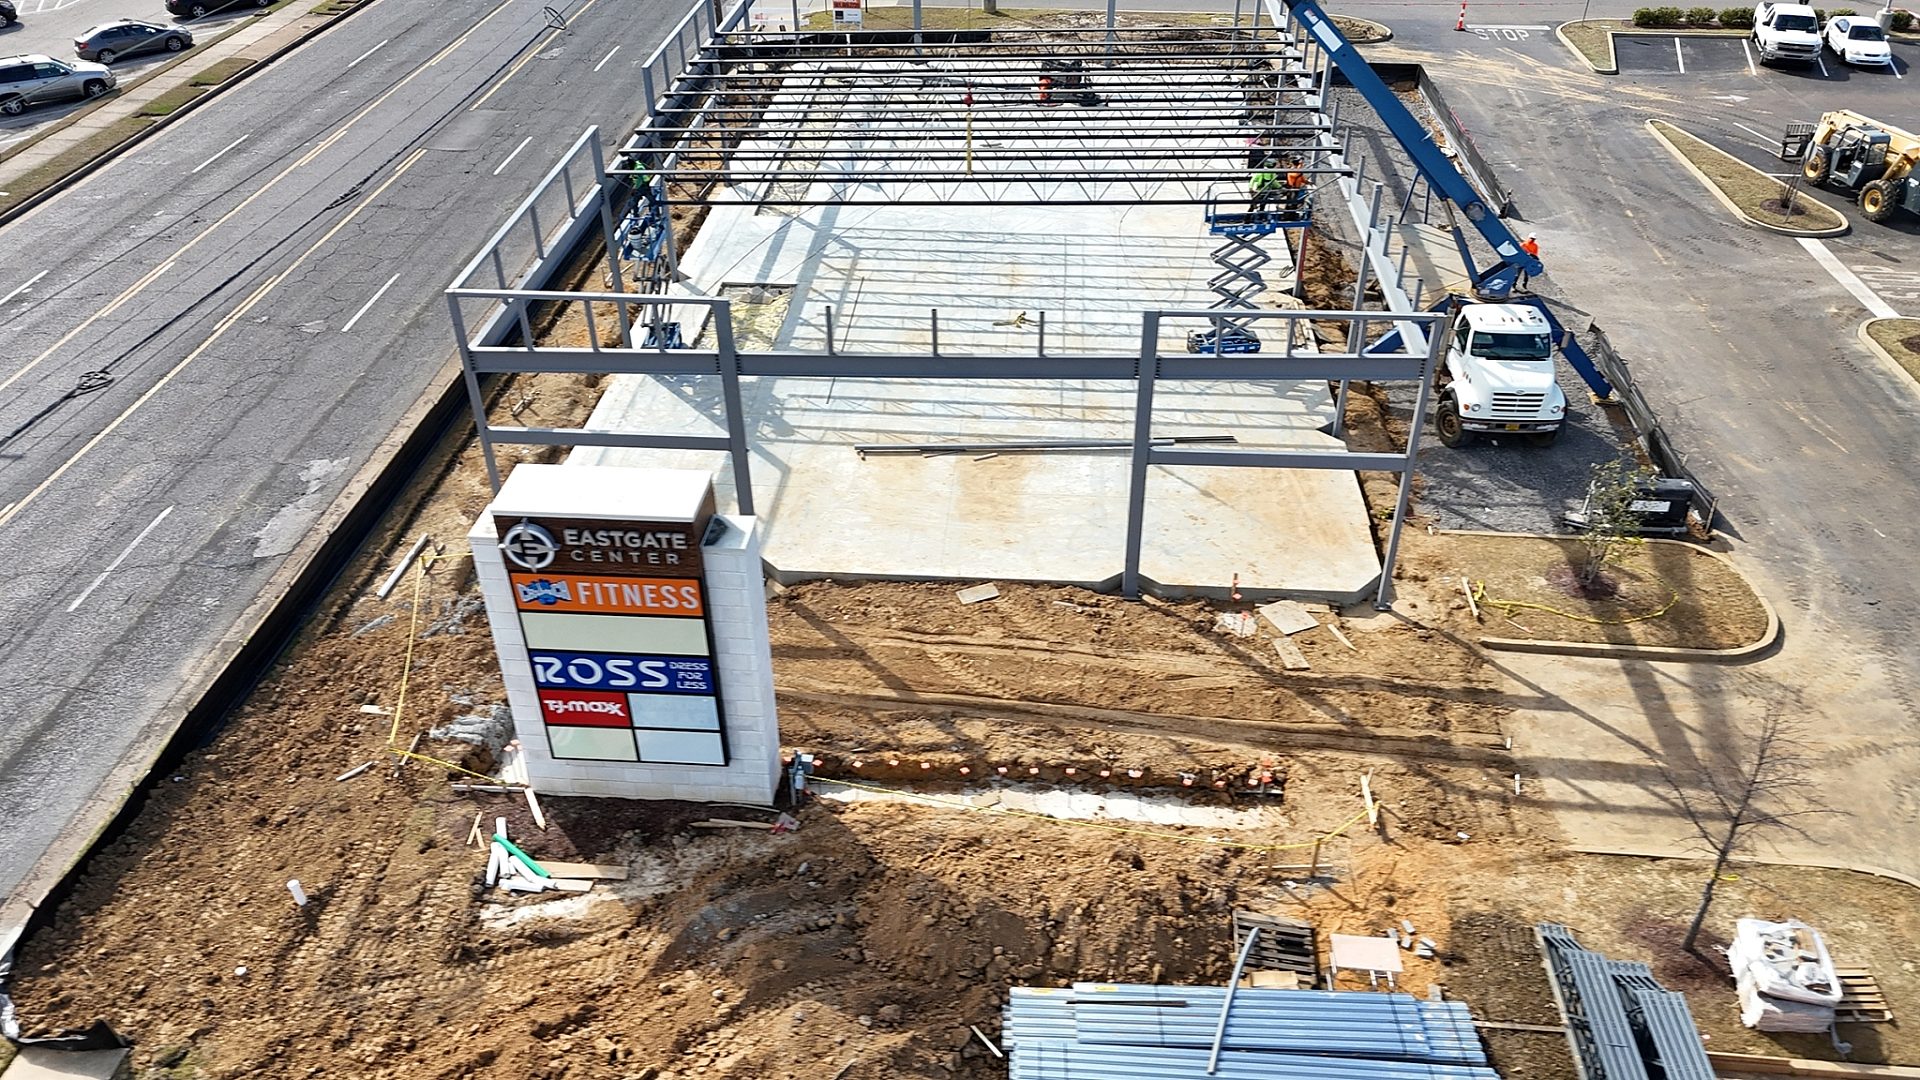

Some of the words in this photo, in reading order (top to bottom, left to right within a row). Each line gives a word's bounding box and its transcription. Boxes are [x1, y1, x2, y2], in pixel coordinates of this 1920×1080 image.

[1474, 28, 1530, 41] STOP
[563, 528, 688, 549] EASTGATE
[570, 550, 679, 565] CENTER
[576, 582, 699, 609] FITNESS
[533, 656, 669, 687] ROSS
[669, 661, 709, 671] DRESS
[677, 671, 704, 681] FOR
[676, 681, 708, 690] LESS
